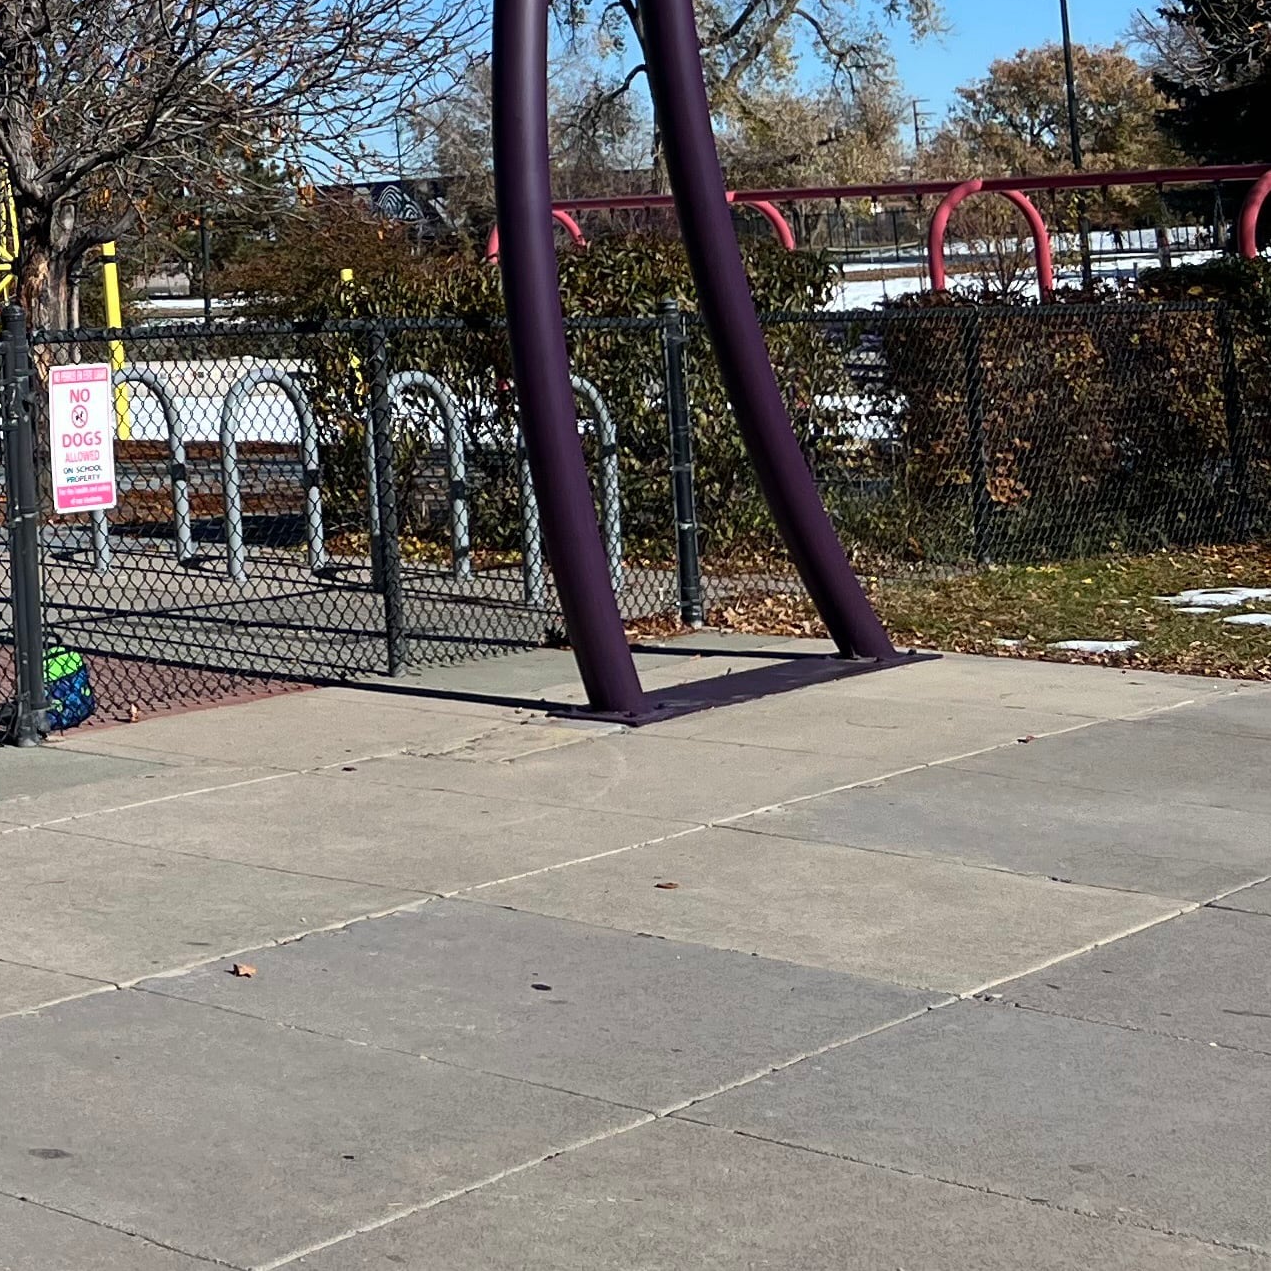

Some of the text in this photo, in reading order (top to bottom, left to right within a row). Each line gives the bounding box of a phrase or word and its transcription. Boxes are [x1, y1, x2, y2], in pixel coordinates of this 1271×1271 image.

[70, 389, 90, 403] NO
[62, 431, 102, 448] DOGS
[65, 450, 100, 463] ALLOWED
[76, 464, 102, 473] SCHOOL
[66, 474, 100, 483] PROPERTY
